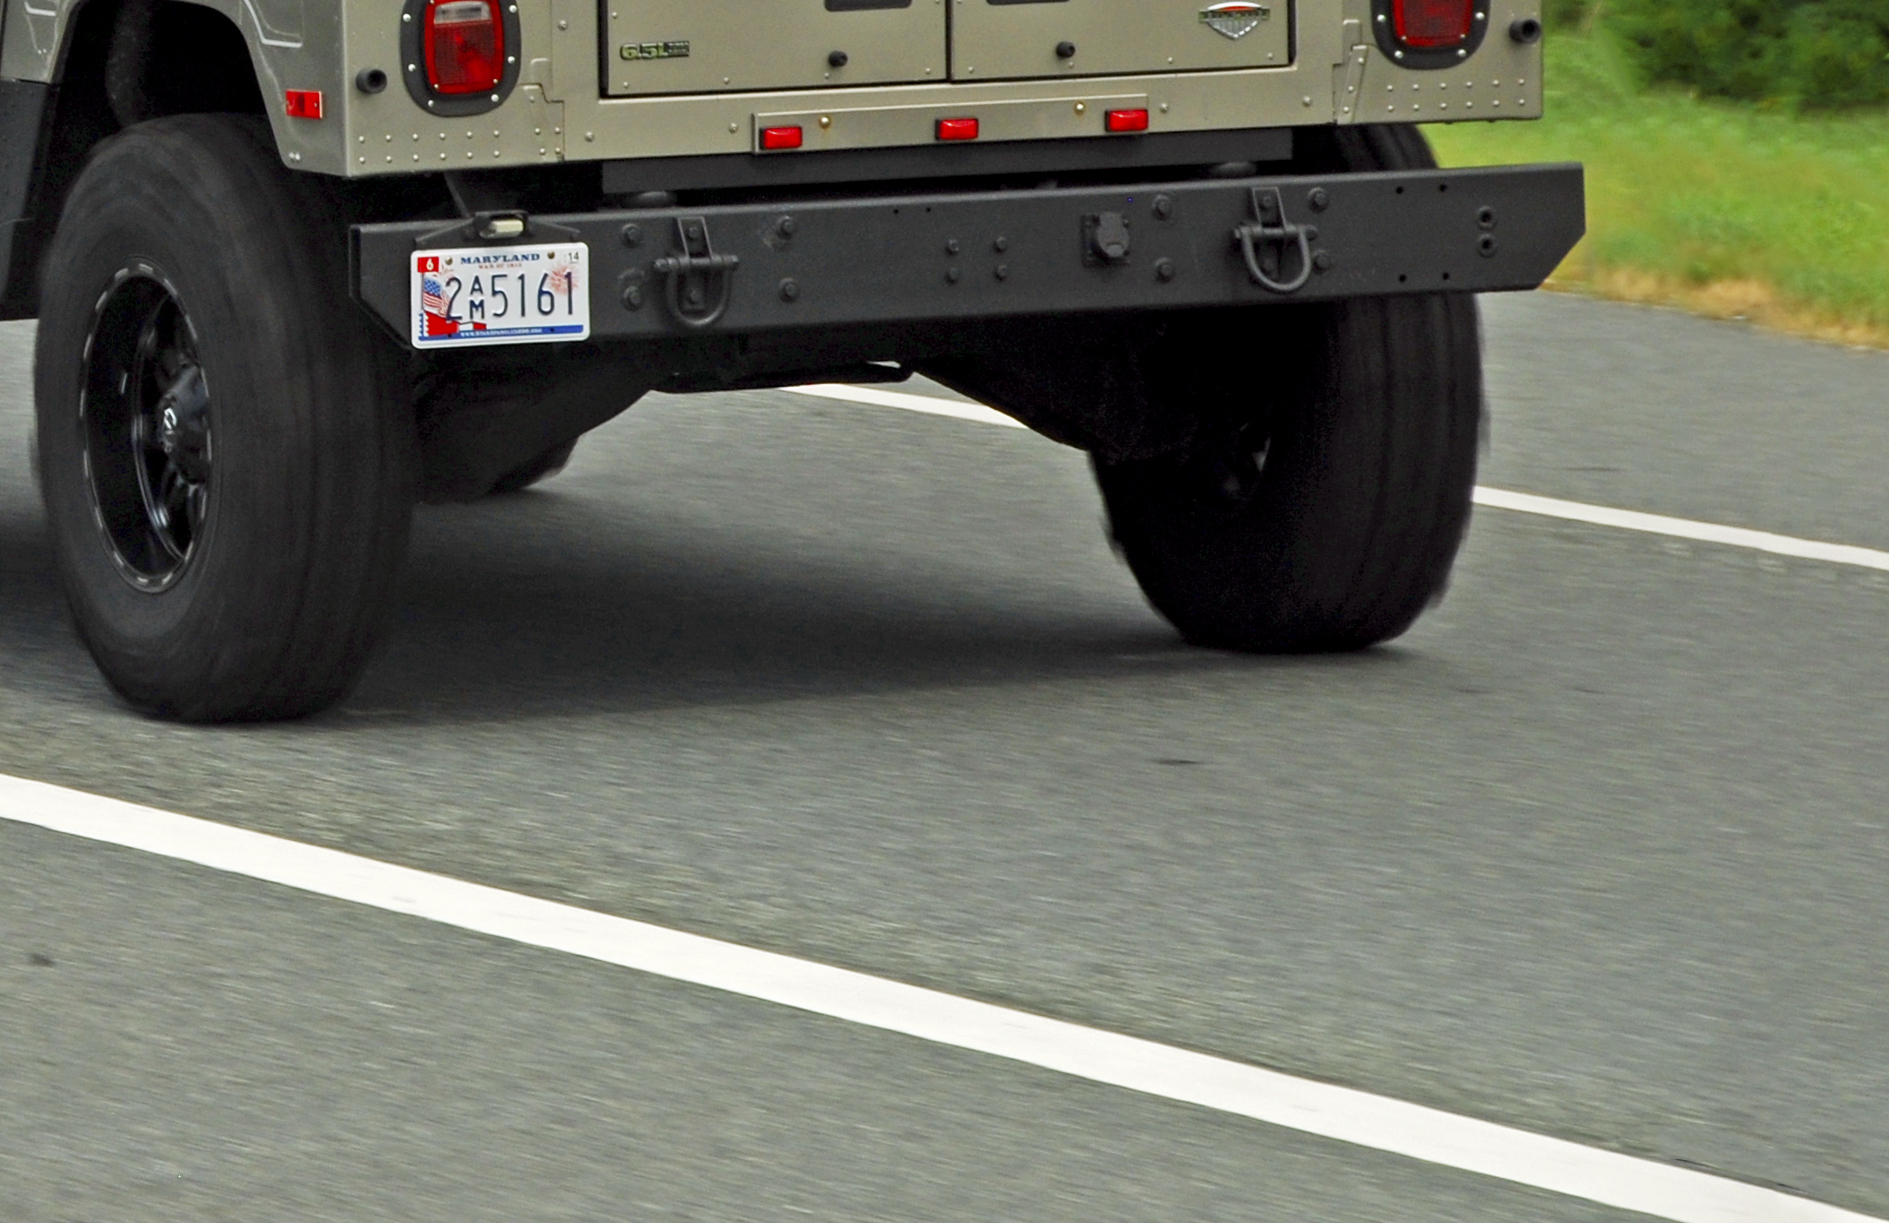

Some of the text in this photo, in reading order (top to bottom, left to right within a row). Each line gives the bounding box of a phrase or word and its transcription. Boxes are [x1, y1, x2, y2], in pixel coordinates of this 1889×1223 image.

[460, 252, 540, 265] MARYLAND
[568, 251, 580, 263] 14
[426, 258, 434, 271] 6
